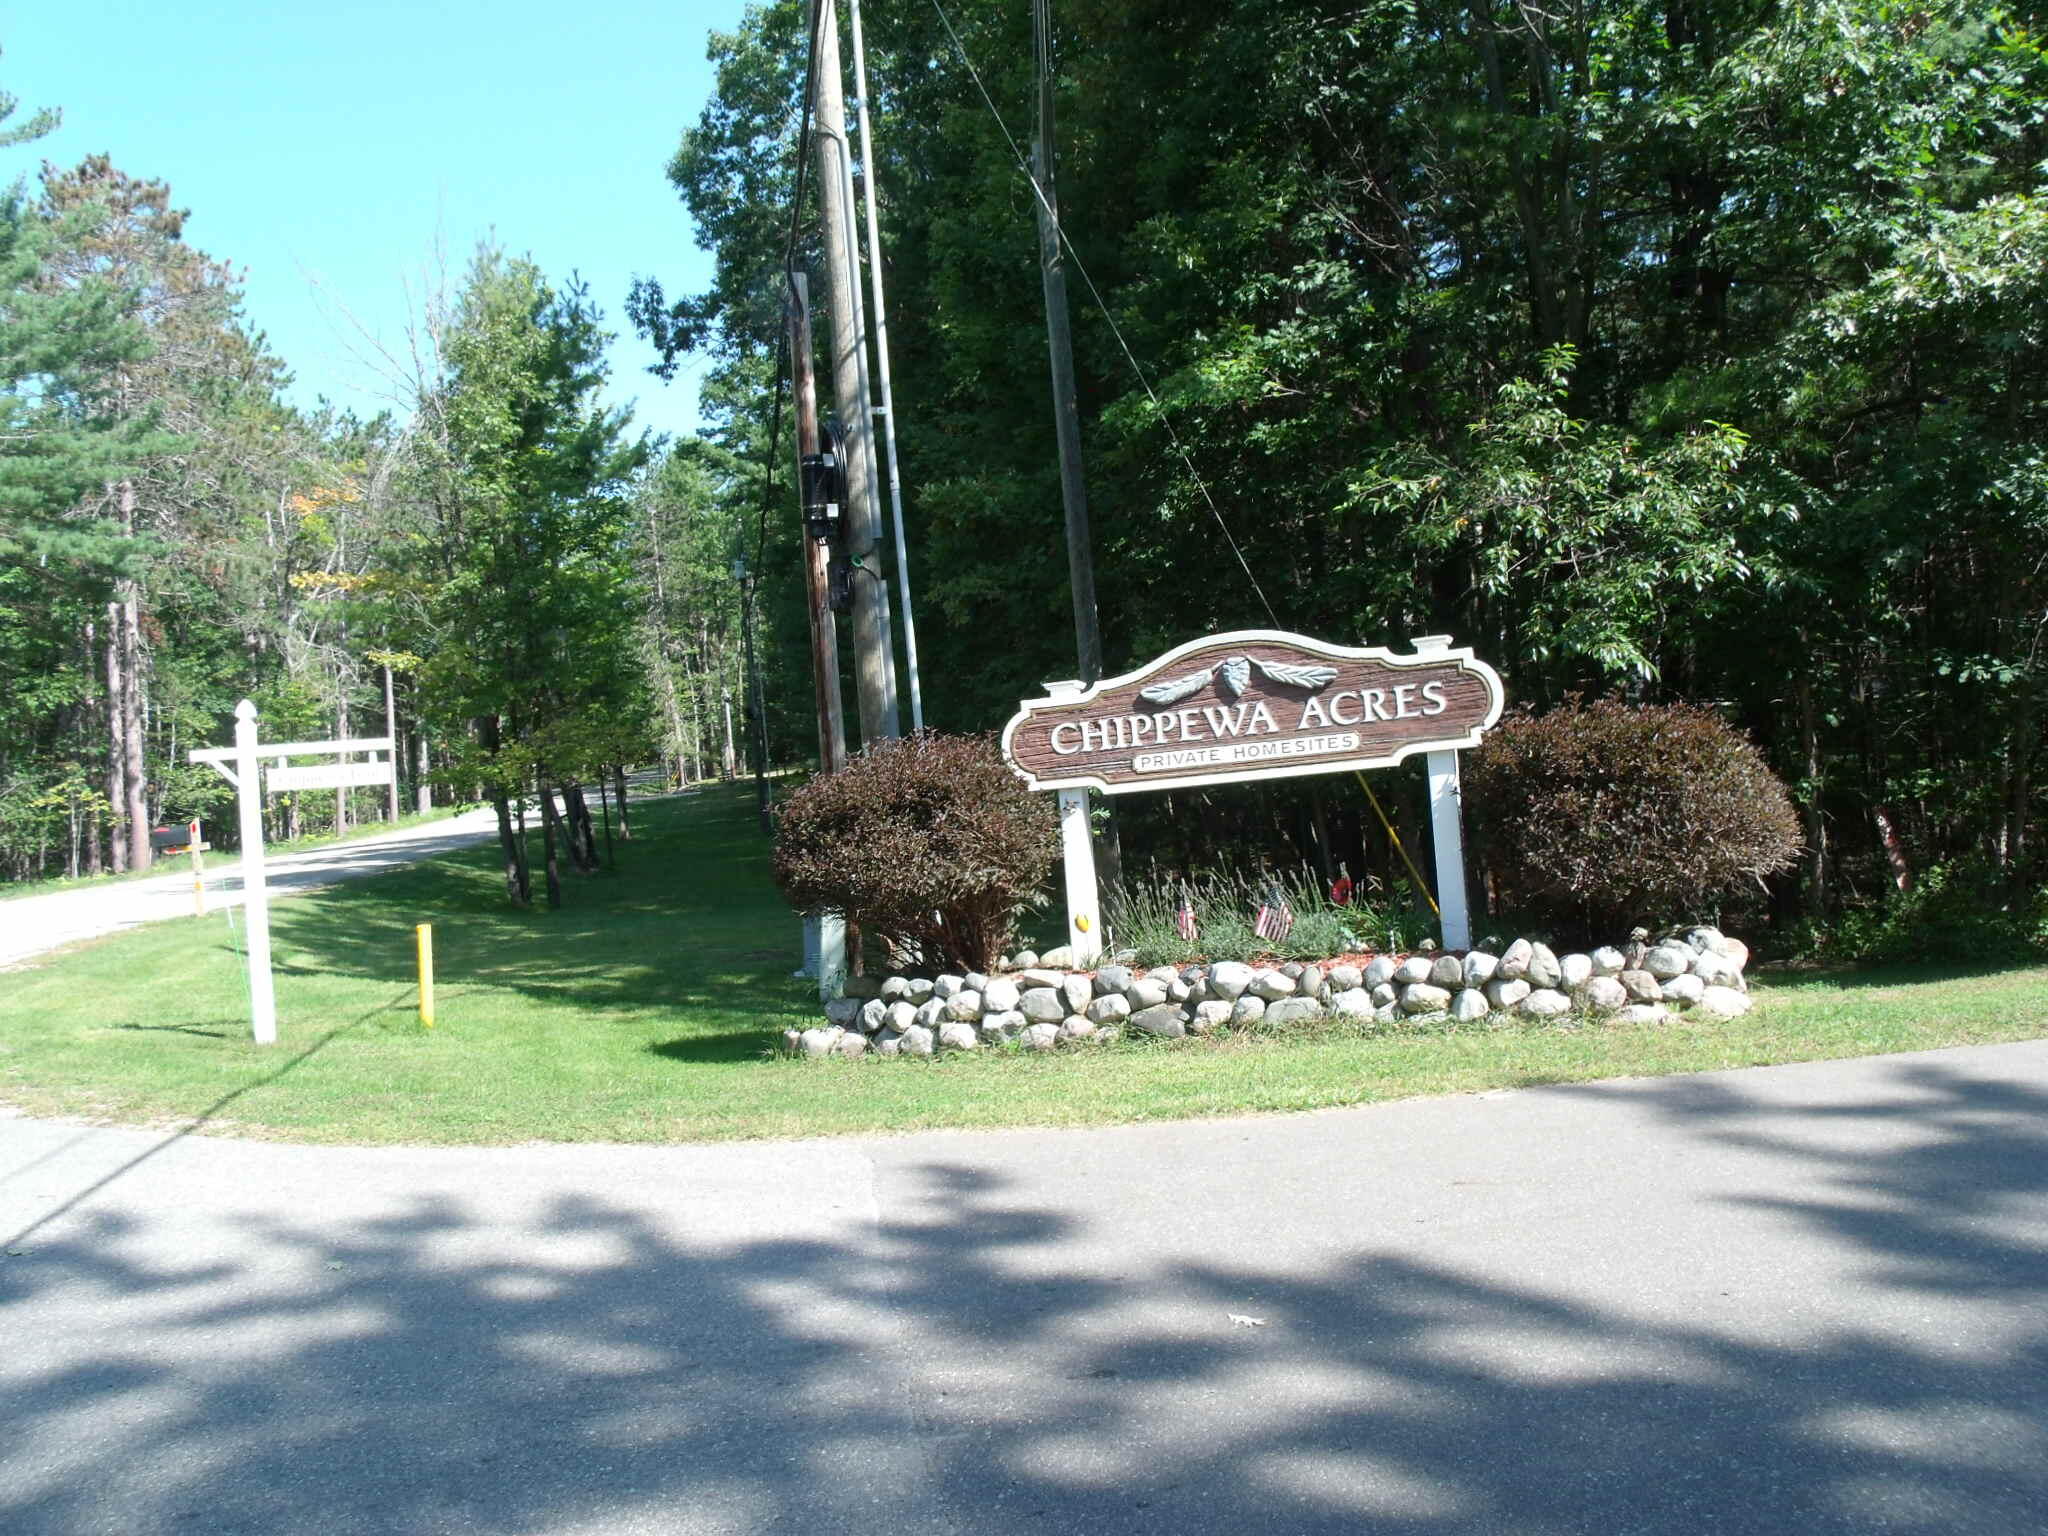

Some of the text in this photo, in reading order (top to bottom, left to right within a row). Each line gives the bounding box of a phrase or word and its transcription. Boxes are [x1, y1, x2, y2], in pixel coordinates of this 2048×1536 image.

[1050, 680, 1448, 755] CHIPPEWA ACRES
[1140, 735, 1354, 768] PRIVATE HOMESITES
